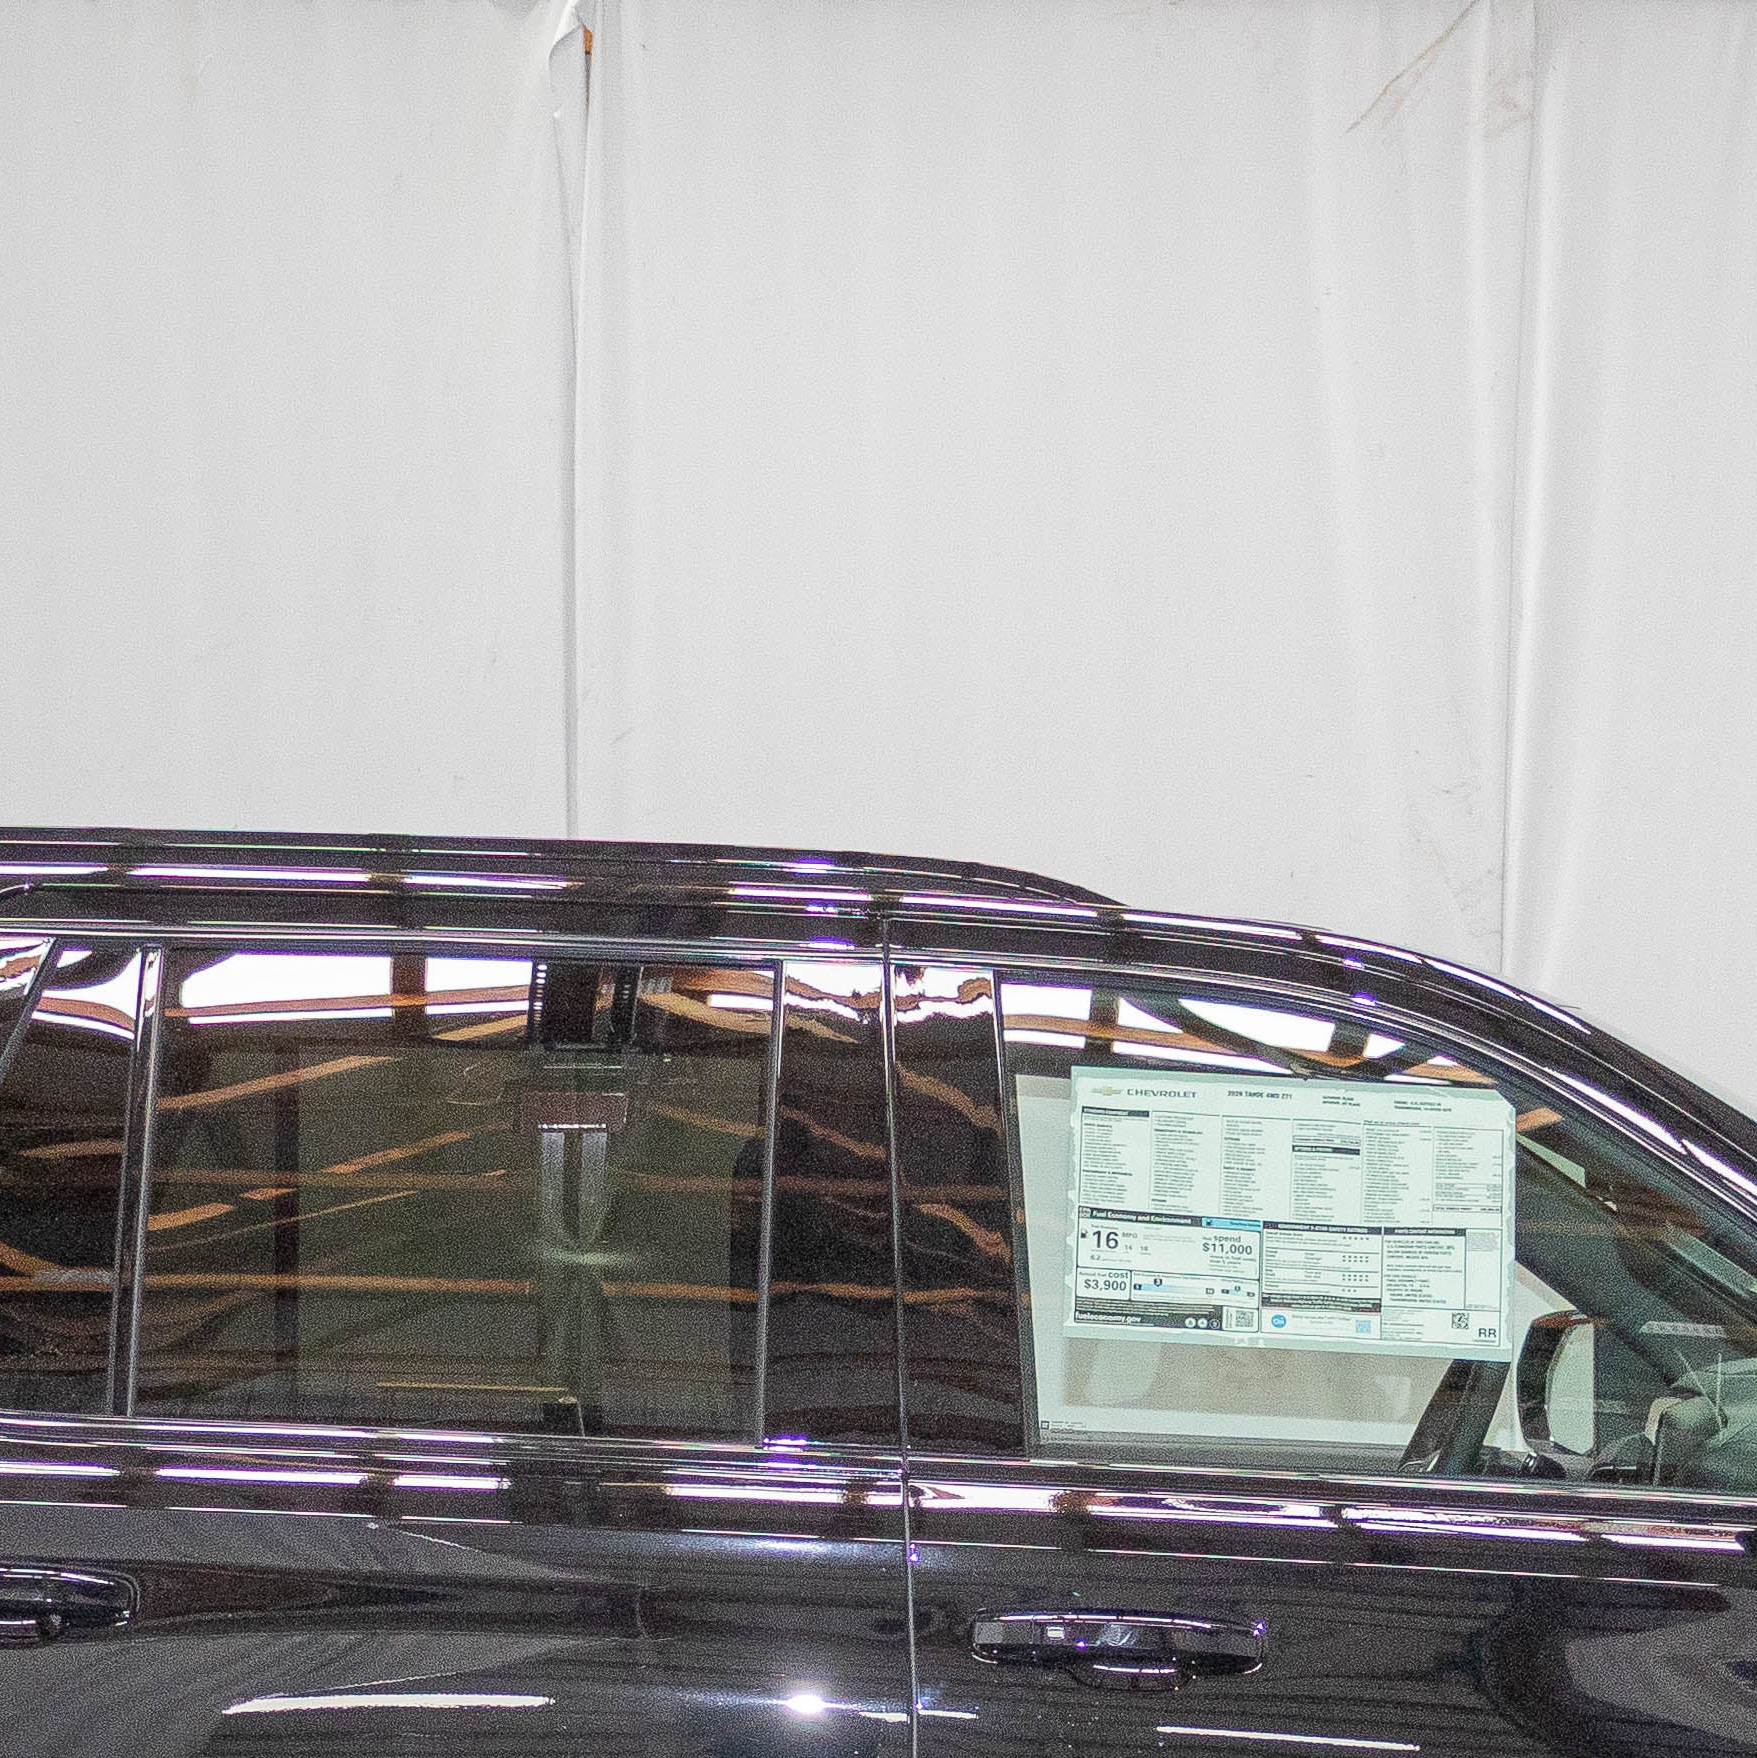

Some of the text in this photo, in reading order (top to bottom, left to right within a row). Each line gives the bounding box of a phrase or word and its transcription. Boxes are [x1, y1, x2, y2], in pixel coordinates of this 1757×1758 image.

[1126, 1088, 1197, 1099] CHEVROLET
[1092, 1230, 1119, 1249] 16
[1213, 1235, 1241, 1243] spend
[1202, 1242, 1253, 1255] $11,000
[1084, 1279, 1127, 1291] $3,900
[1478, 1327, 1497, 1338] RR
